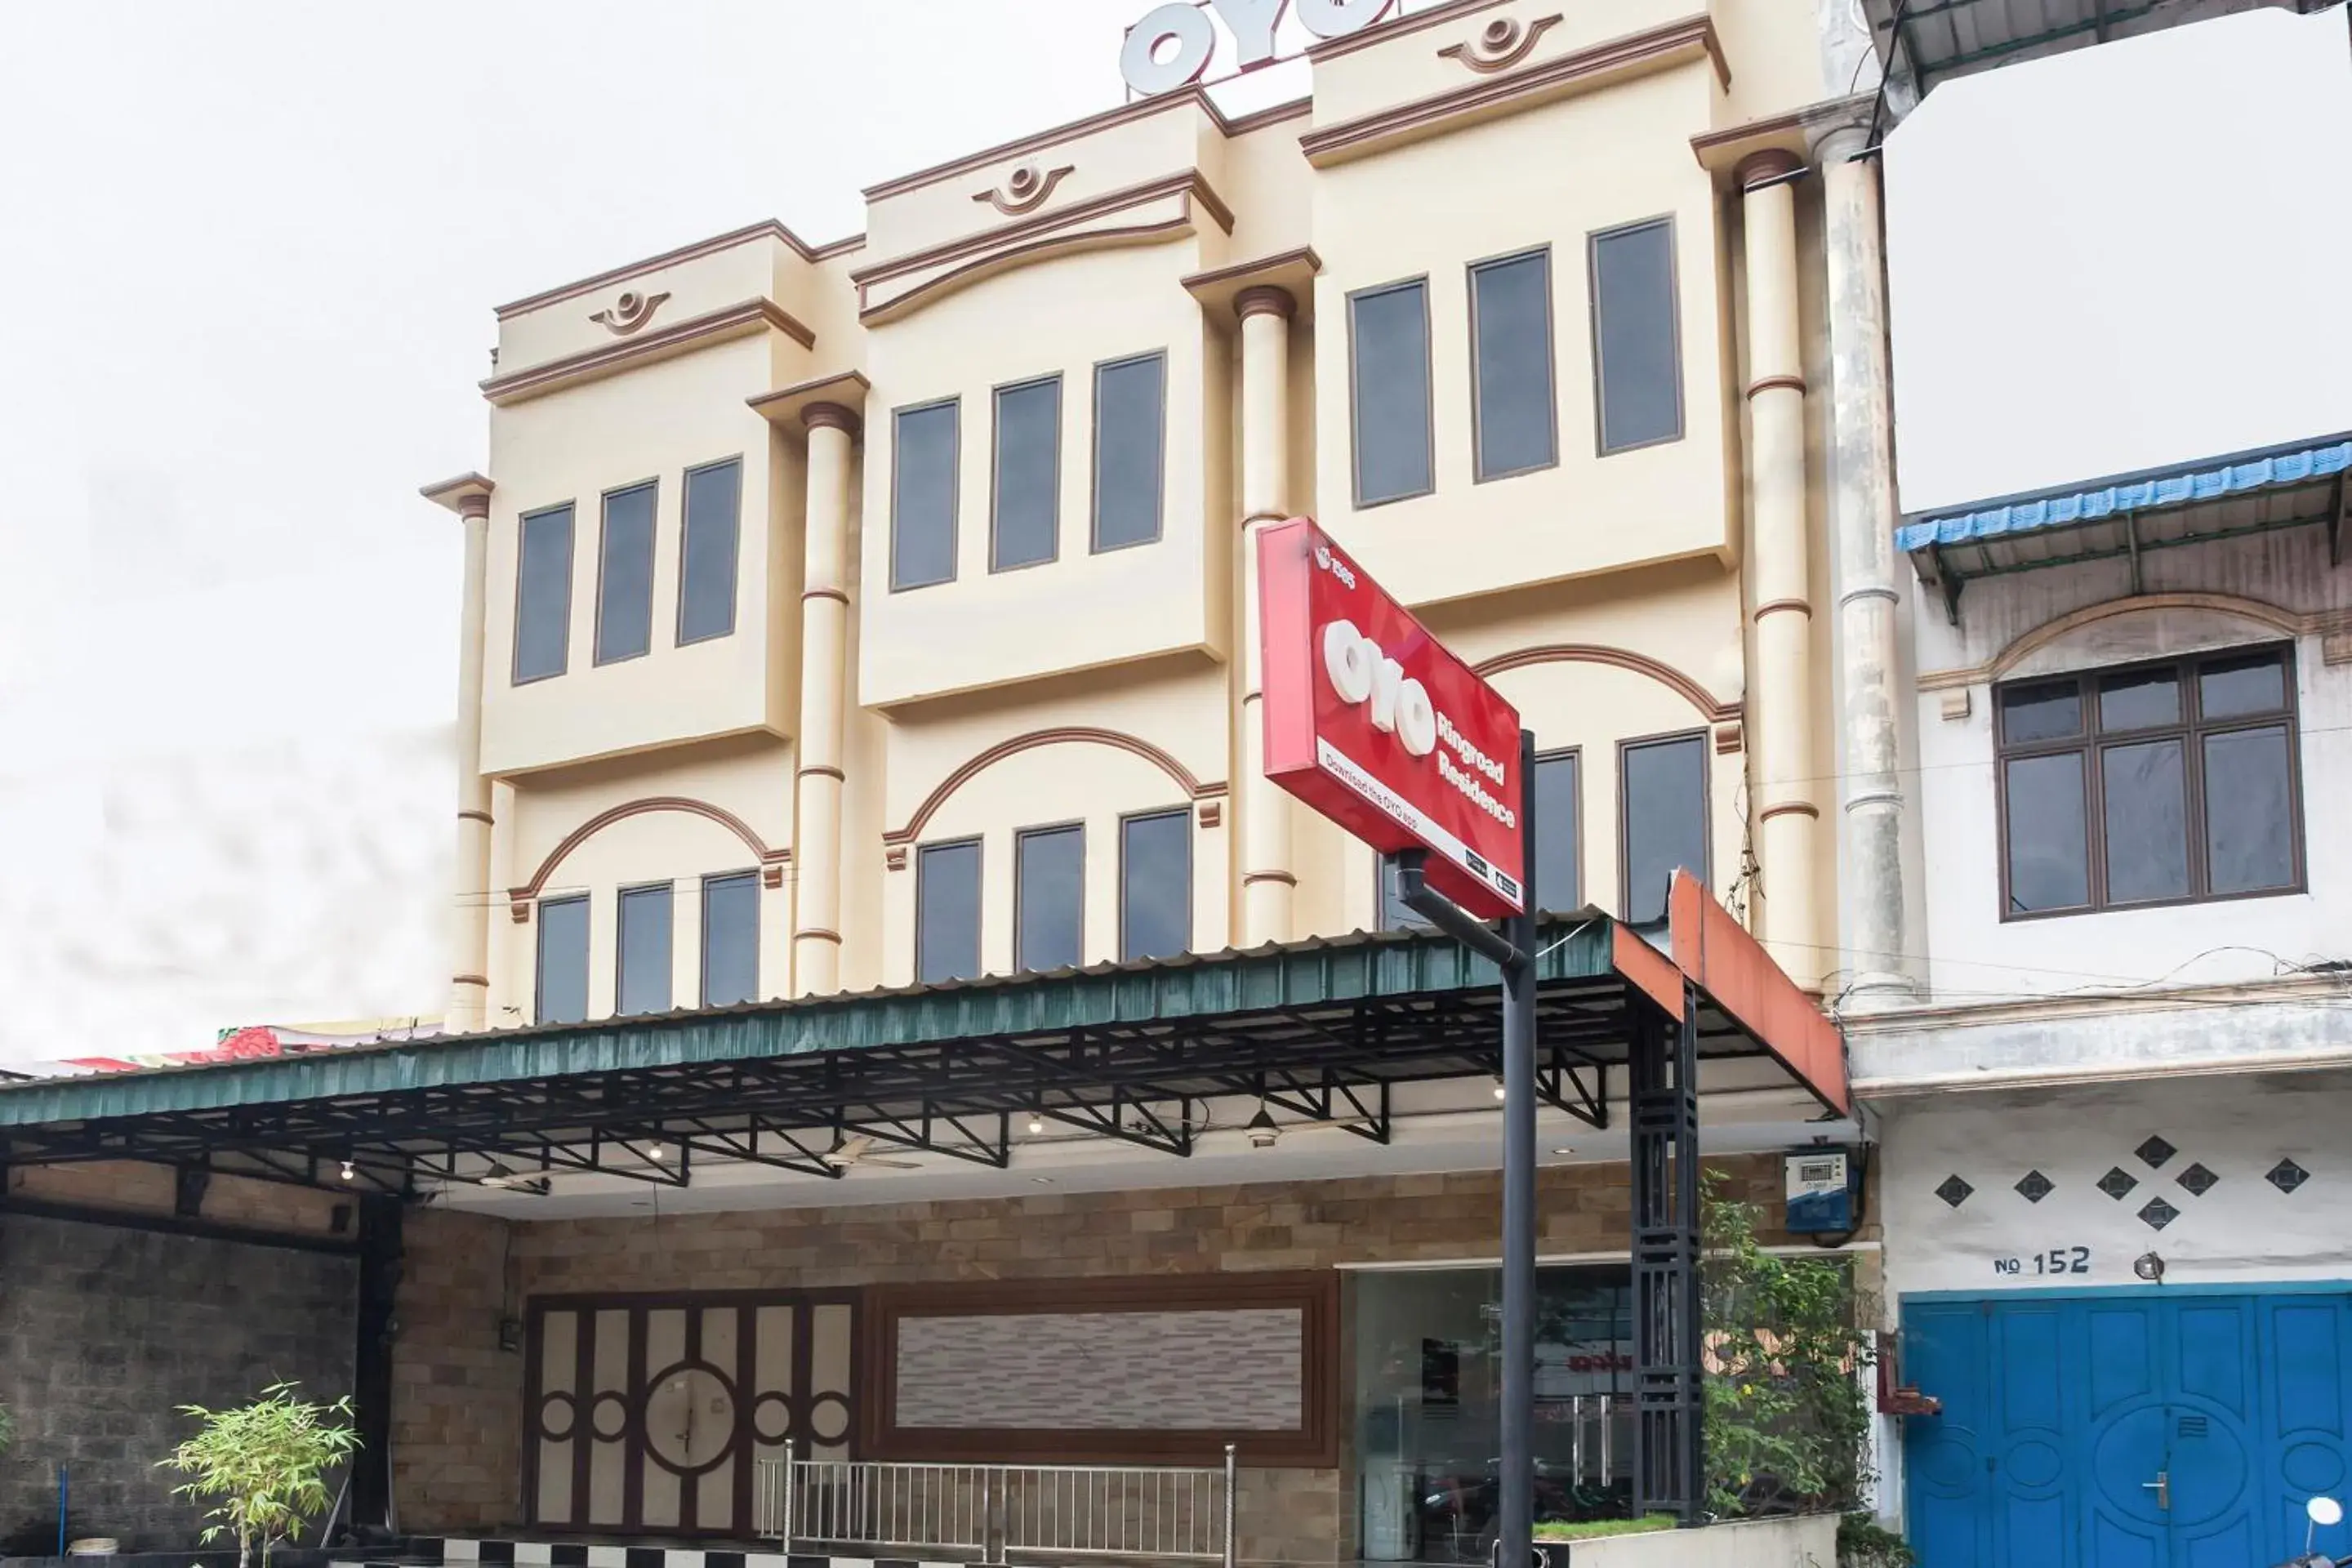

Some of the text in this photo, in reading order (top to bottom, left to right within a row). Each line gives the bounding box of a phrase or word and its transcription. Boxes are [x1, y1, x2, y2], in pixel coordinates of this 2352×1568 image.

[1323, 618, 1437, 756] OYO
[1325, 753, 1368, 794] Download
[1369, 785, 1383, 804] the
[1383, 794, 1403, 817] OYO
[1437, 711, 1504, 786] Ringroad
[1437, 751, 1516, 829] Residence
[2033, 1245, 2091, 1274] 152
